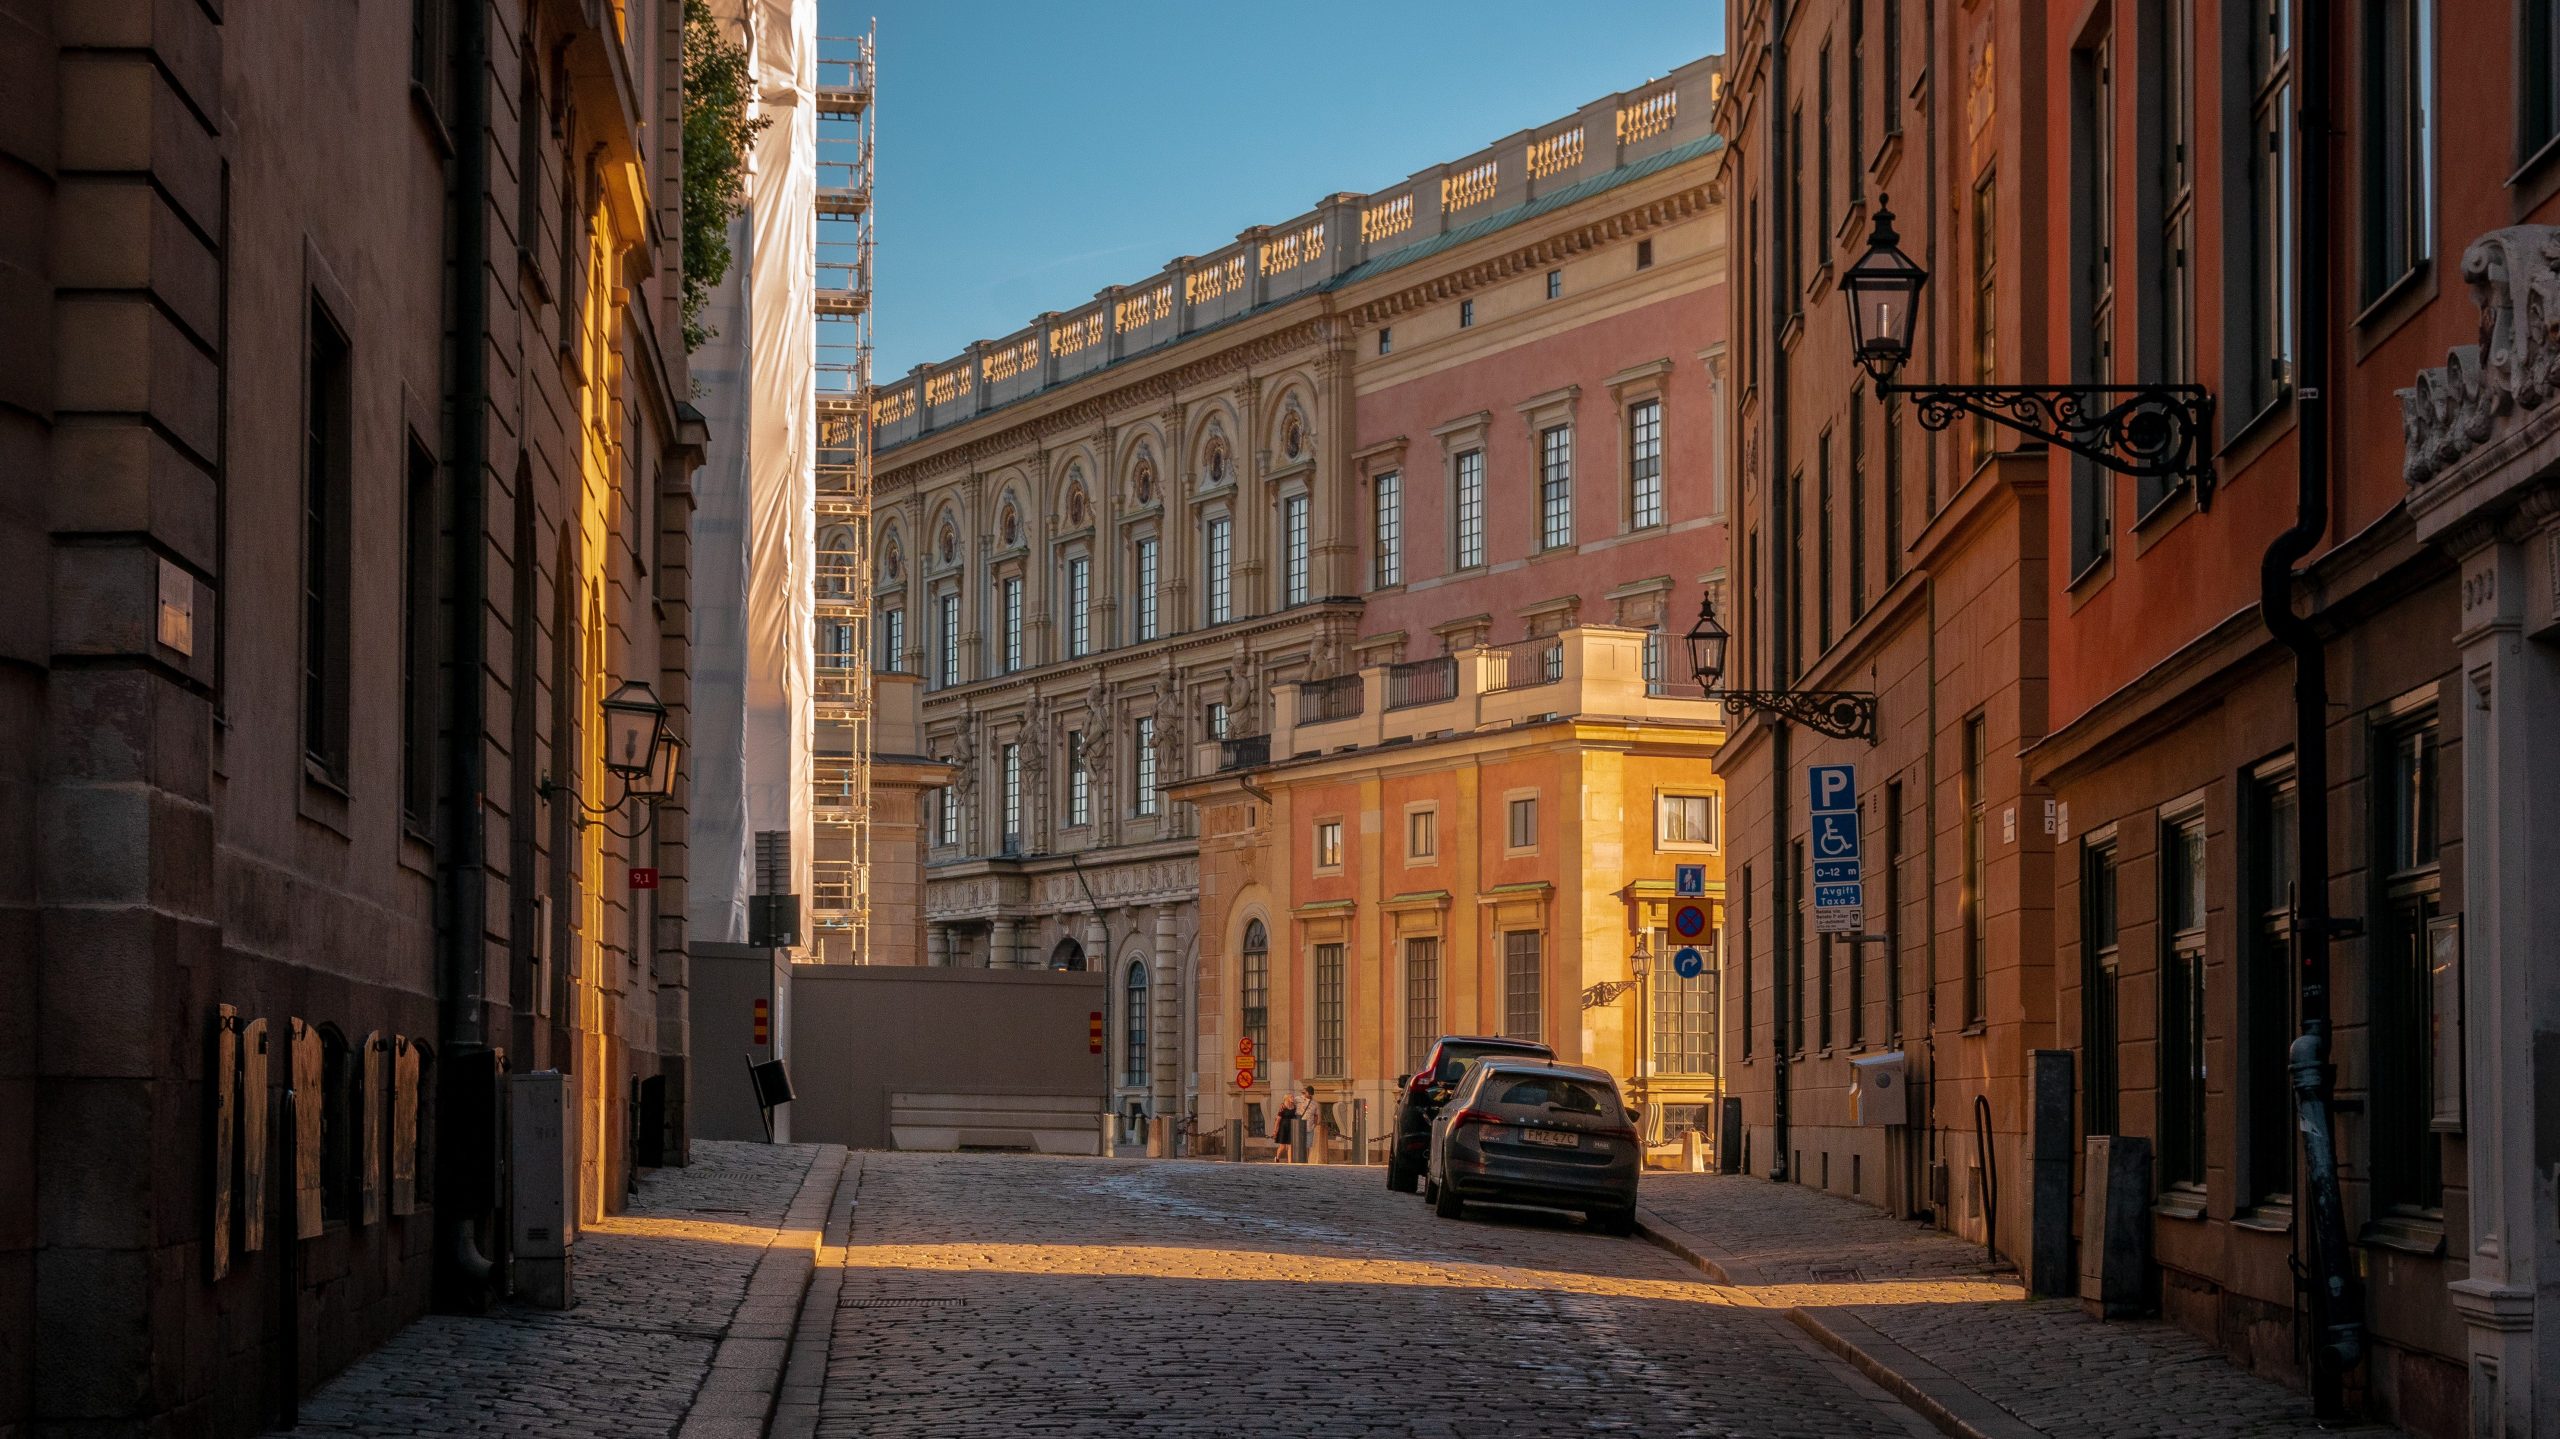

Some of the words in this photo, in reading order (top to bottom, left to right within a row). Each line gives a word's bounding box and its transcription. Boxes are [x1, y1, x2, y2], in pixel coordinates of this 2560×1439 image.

[1821, 770, 1848, 806] P
[2048, 804, 2054, 813] T
[2048, 821, 2054, 830] 2
[1816, 868, 1840, 877] 0-12
[1822, 886, 1853, 896] Avgift
[1820, 897, 1846, 905] Taxa
[1849, 896, 1856, 904] 2
